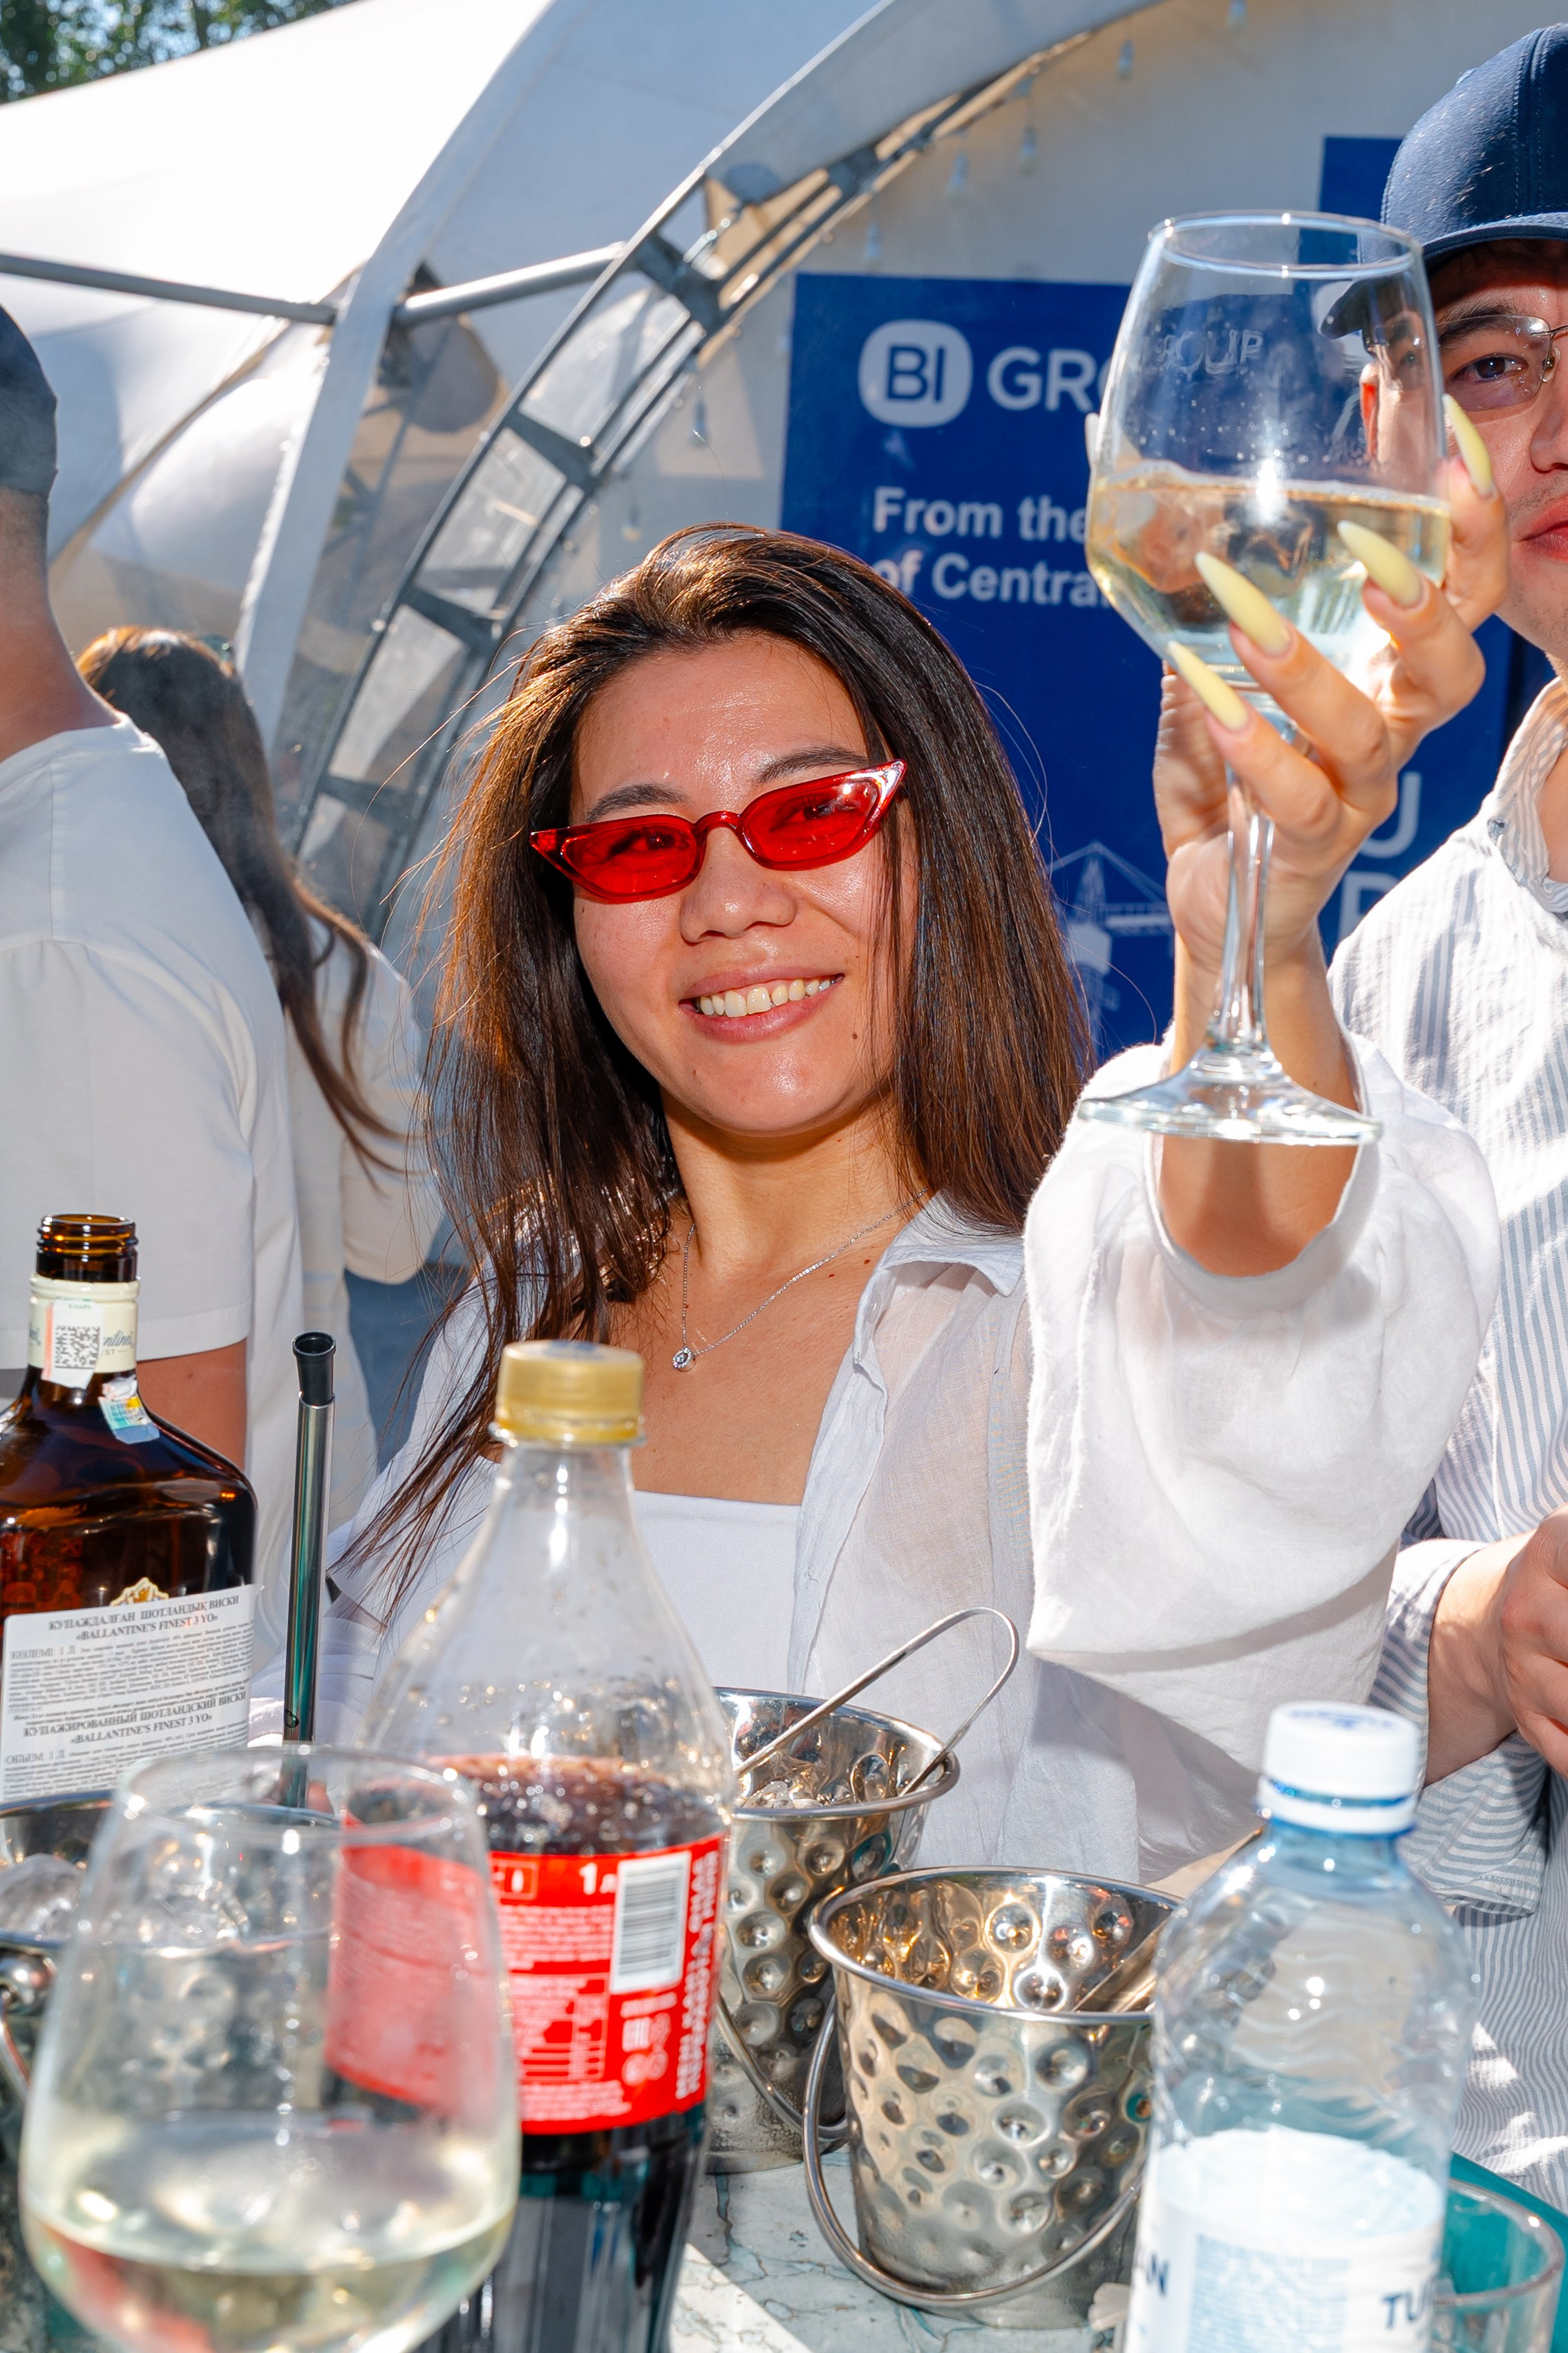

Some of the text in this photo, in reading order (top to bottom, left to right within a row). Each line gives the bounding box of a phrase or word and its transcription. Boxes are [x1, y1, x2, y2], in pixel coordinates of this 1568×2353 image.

[886, 345, 946, 406] BI
[873, 486, 1086, 545] From the
[159, 1617, 192, 1631] FINEST
[193, 1615, 200, 1625] 3
[140, 1697, 216, 1722] ШОТЛАНДСКИЙ
[218, 1691, 247, 1707] ВИСКИ
[153, 1717, 187, 1732] FINEST
[189, 1716, 194, 1726] 3
